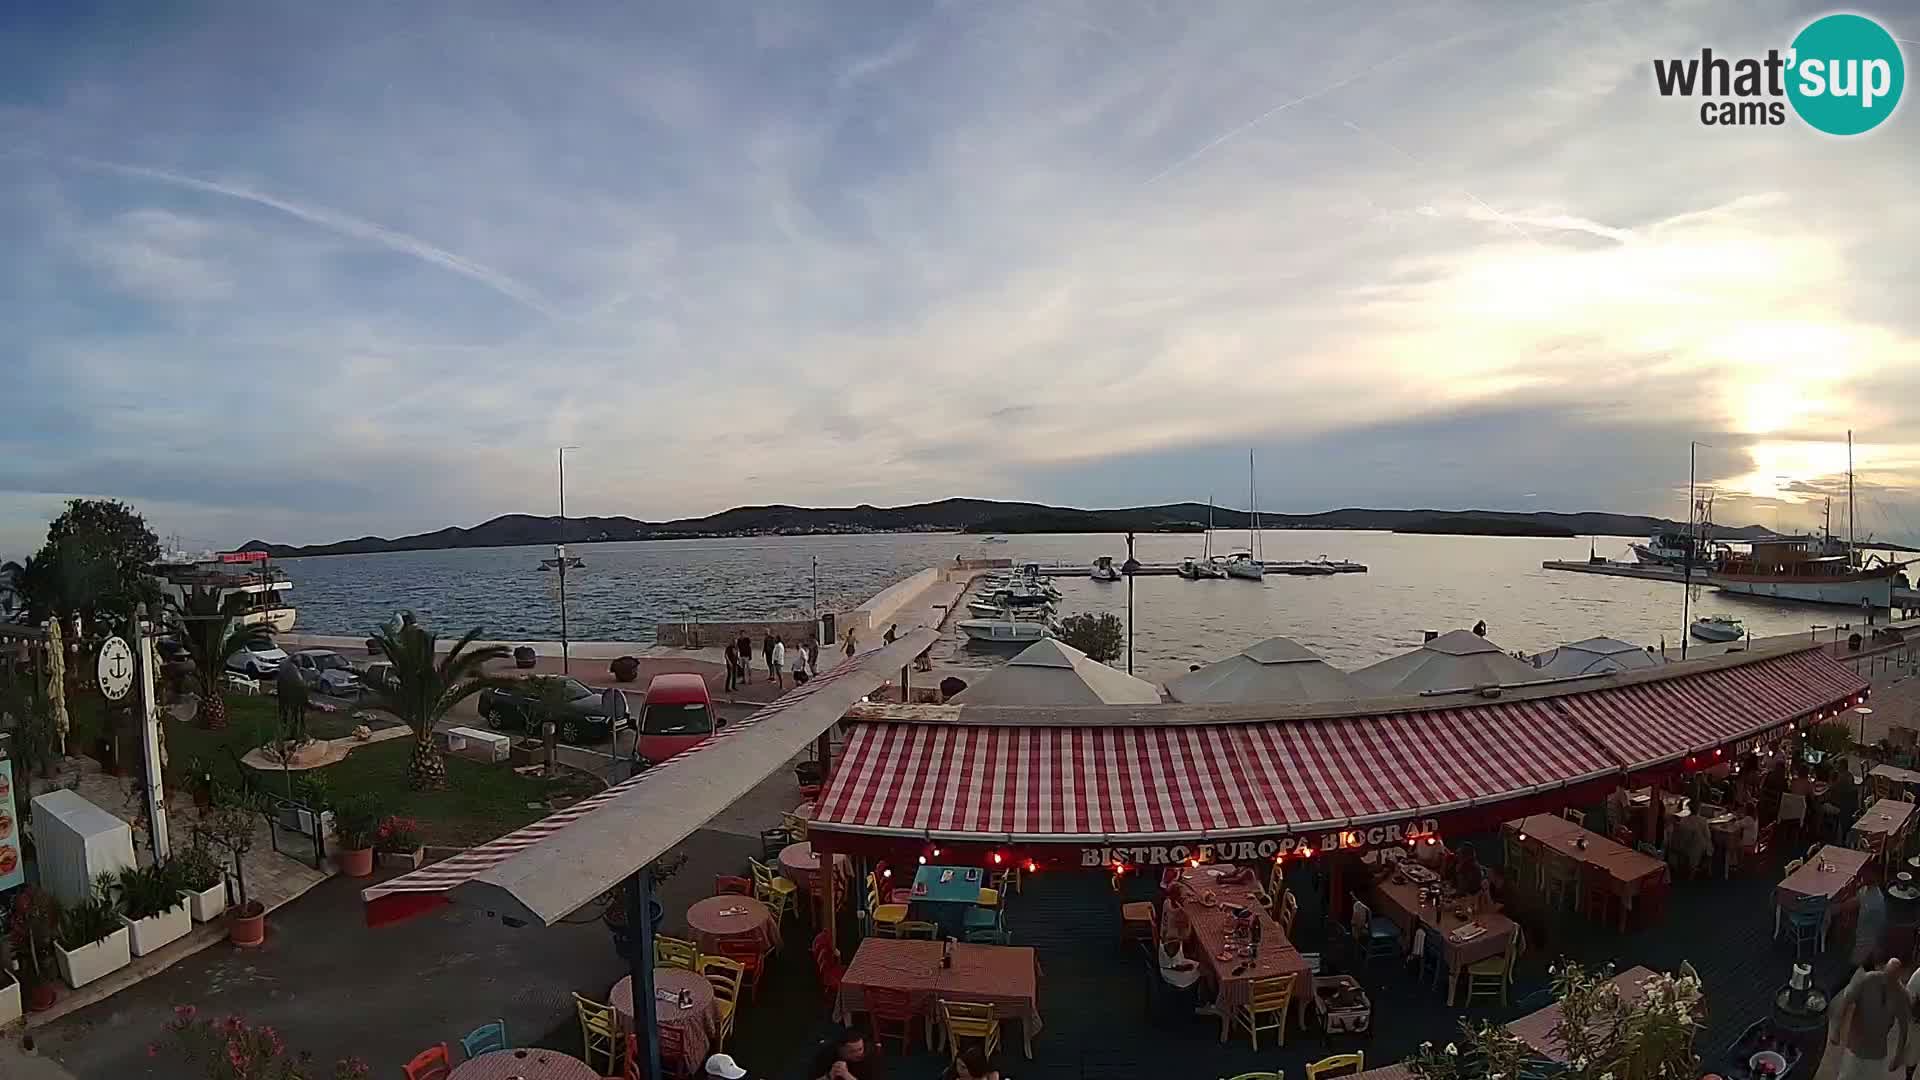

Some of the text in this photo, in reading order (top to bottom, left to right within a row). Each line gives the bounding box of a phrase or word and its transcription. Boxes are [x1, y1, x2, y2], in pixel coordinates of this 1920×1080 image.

[1080, 819, 1438, 866] BISTRO EUROPA BIOGRAD
